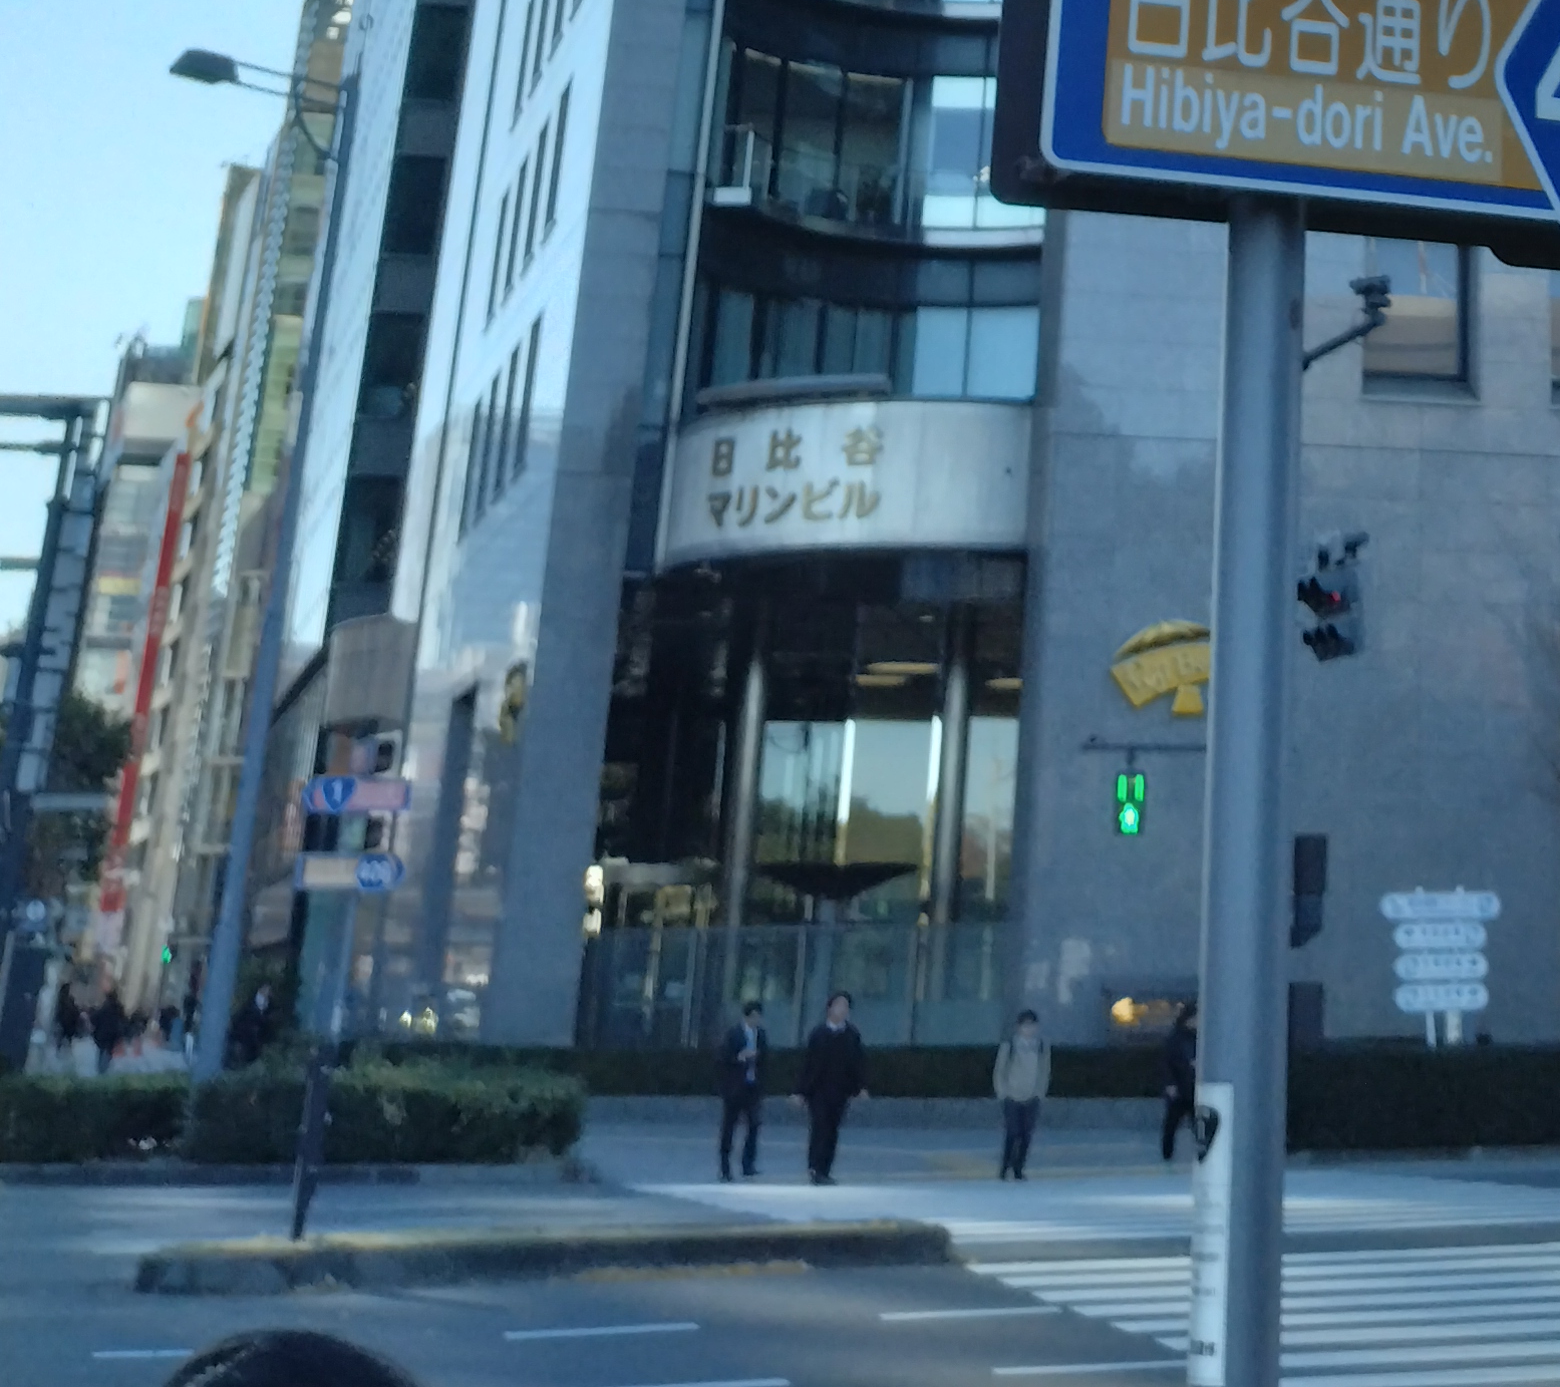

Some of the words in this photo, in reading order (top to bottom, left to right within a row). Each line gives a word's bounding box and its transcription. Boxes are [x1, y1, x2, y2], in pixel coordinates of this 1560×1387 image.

[1120, 62, 1384, 151] Hibiya-dori
[1400, 94, 1494, 164] Ave.
[712, 427, 883, 476] 日比谷
[709, 478, 881, 528] マリンビル
